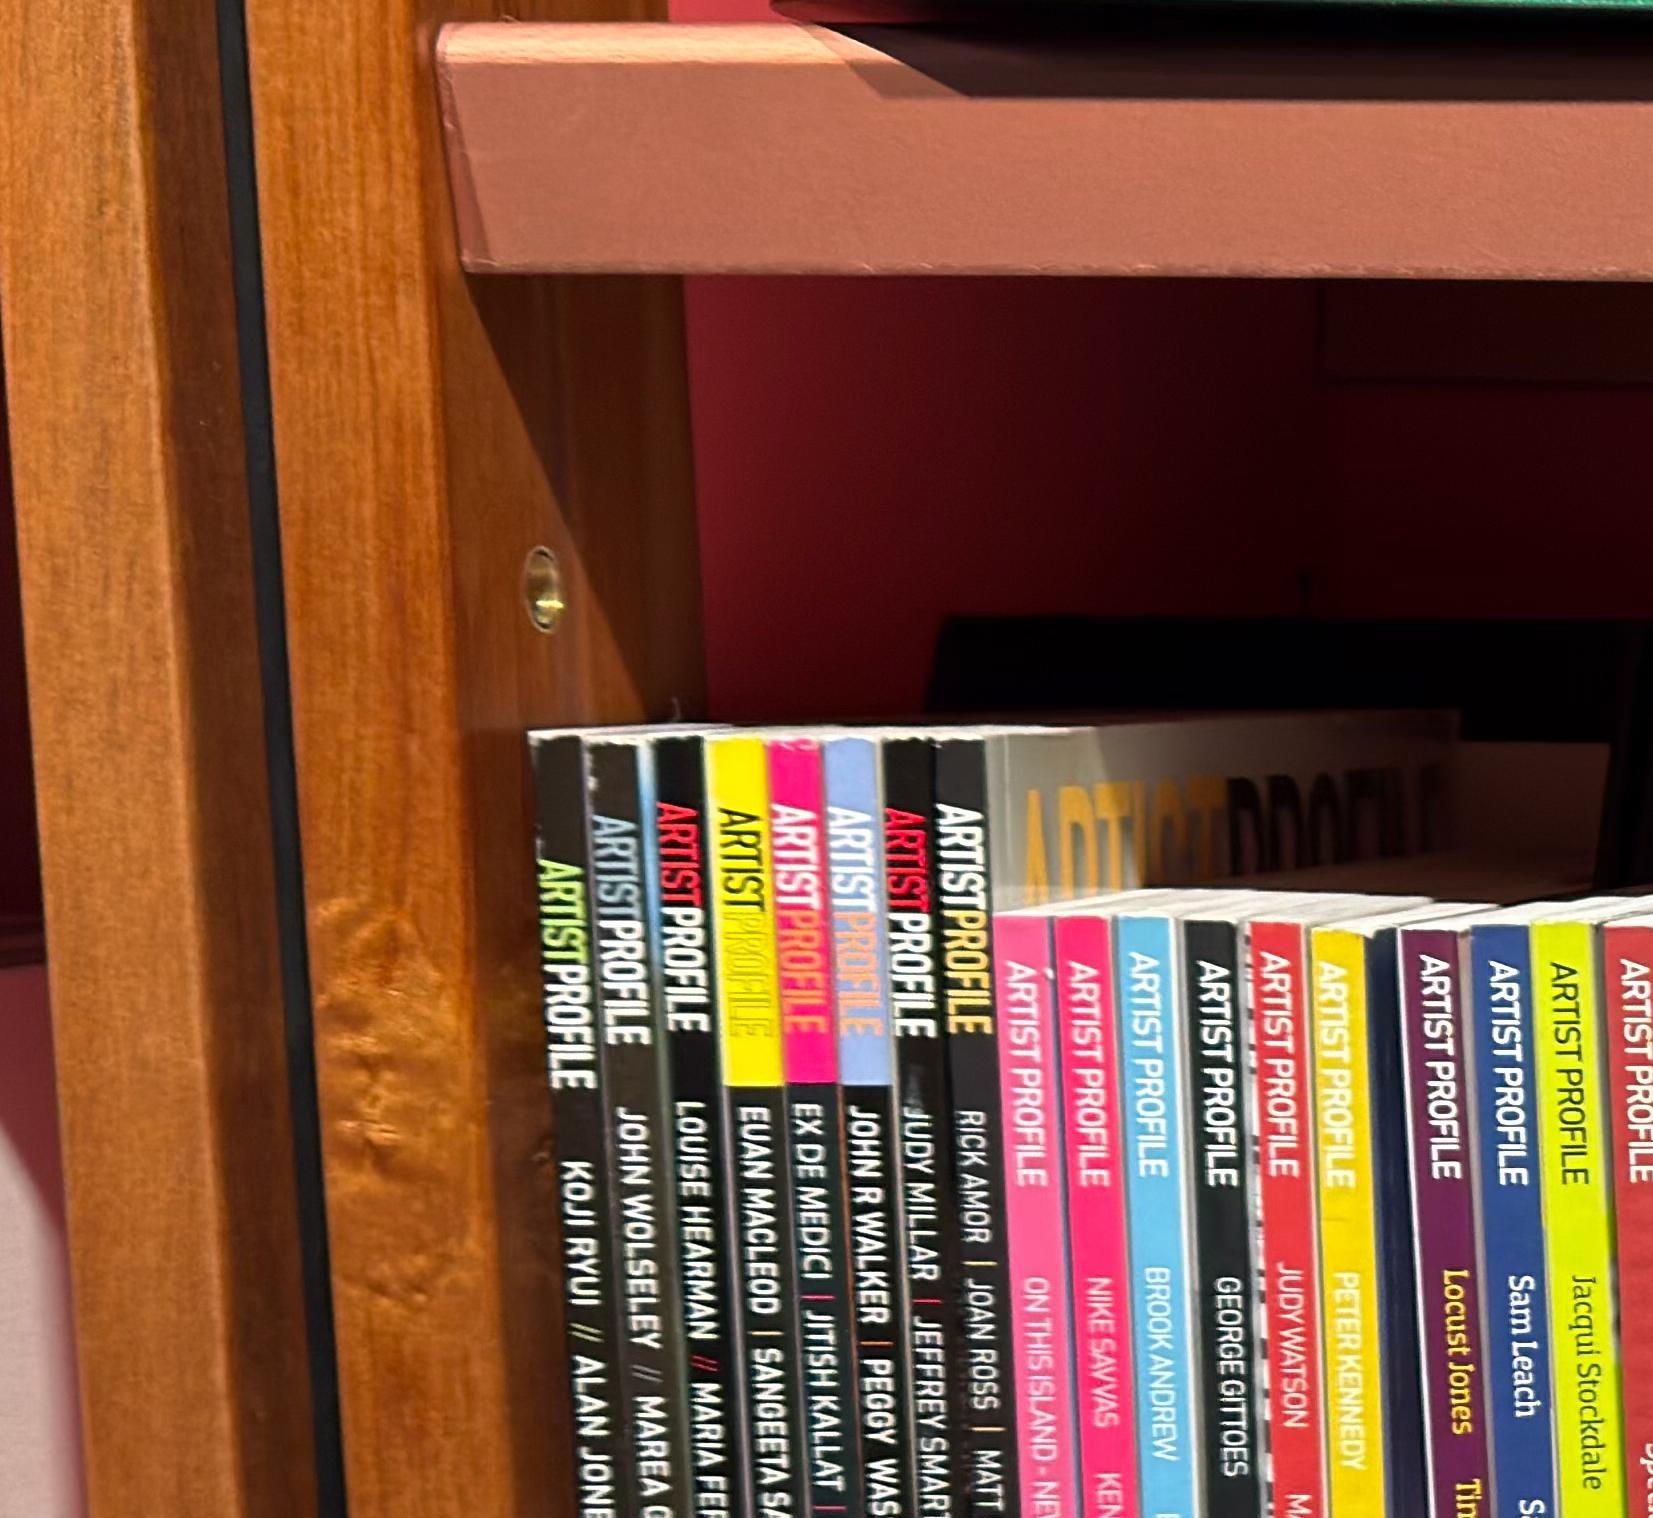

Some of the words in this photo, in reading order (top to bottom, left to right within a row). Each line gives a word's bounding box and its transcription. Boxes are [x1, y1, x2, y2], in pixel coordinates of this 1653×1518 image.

[1197, 961, 1233, 1062] ARTIST
[1621, 959, 1653, 1060] ARTIST
[676, 1102, 710, 1196] LOUISE
[957, 1111, 987, 1166] RICK
[1204, 1068, 1238, 1186] PROFILE
[561, 1162, 595, 1225] KOJI
[961, 1174, 991, 1243] AMOR
[566, 1238, 601, 1305] RYUI
[682, 1207, 718, 1339] HEARMAN
[1088, 1278, 1114, 1332] NIKE
[1145, 1268, 1173, 1350] BROOK
[1444, 1270, 1470, 1355] Locust
[1509, 1276, 1535, 1335] Sam
[1091, 1339, 1118, 1427] SAVVAS
[1149, 1354, 1179, 1460] ANDREW
[1448, 1362, 1475, 1434] Jones
[1512, 1341, 1541, 1417] Leach
